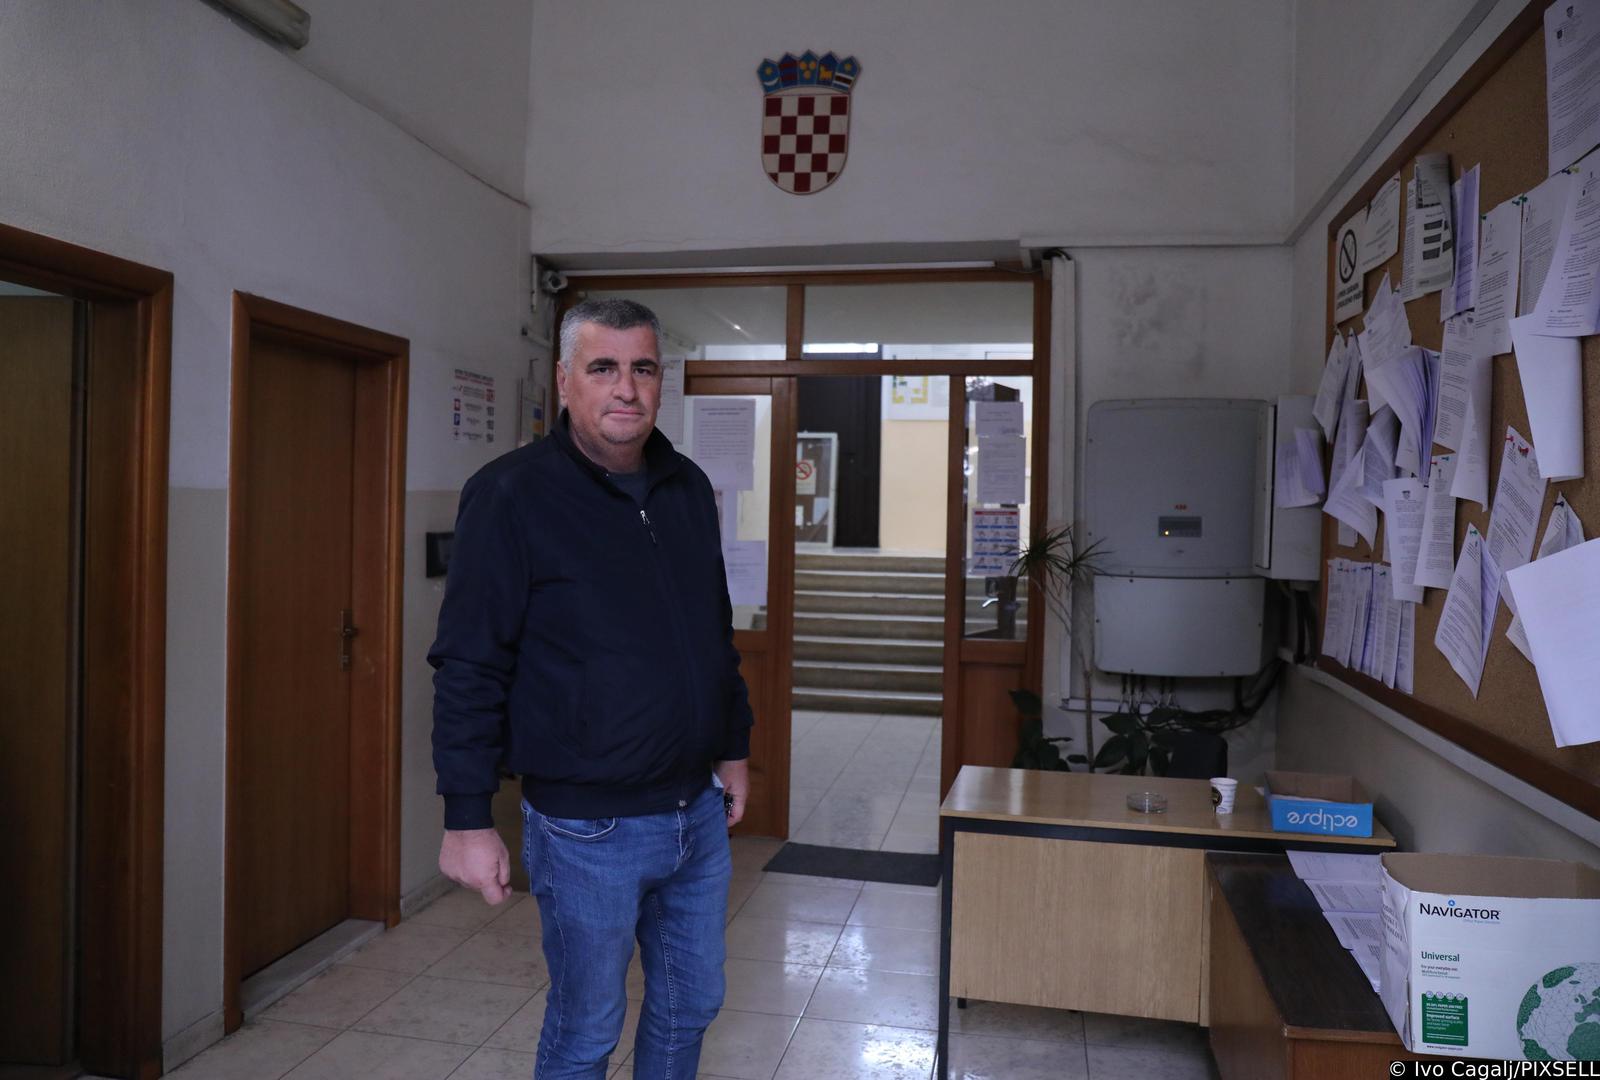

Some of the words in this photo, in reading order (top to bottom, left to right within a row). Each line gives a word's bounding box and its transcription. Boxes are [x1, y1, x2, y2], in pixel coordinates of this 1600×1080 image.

[1287, 808, 1359, 832] eclipse
[1419, 902, 1500, 920] NAVIGATOR
[1421, 951, 1460, 962] Universal
